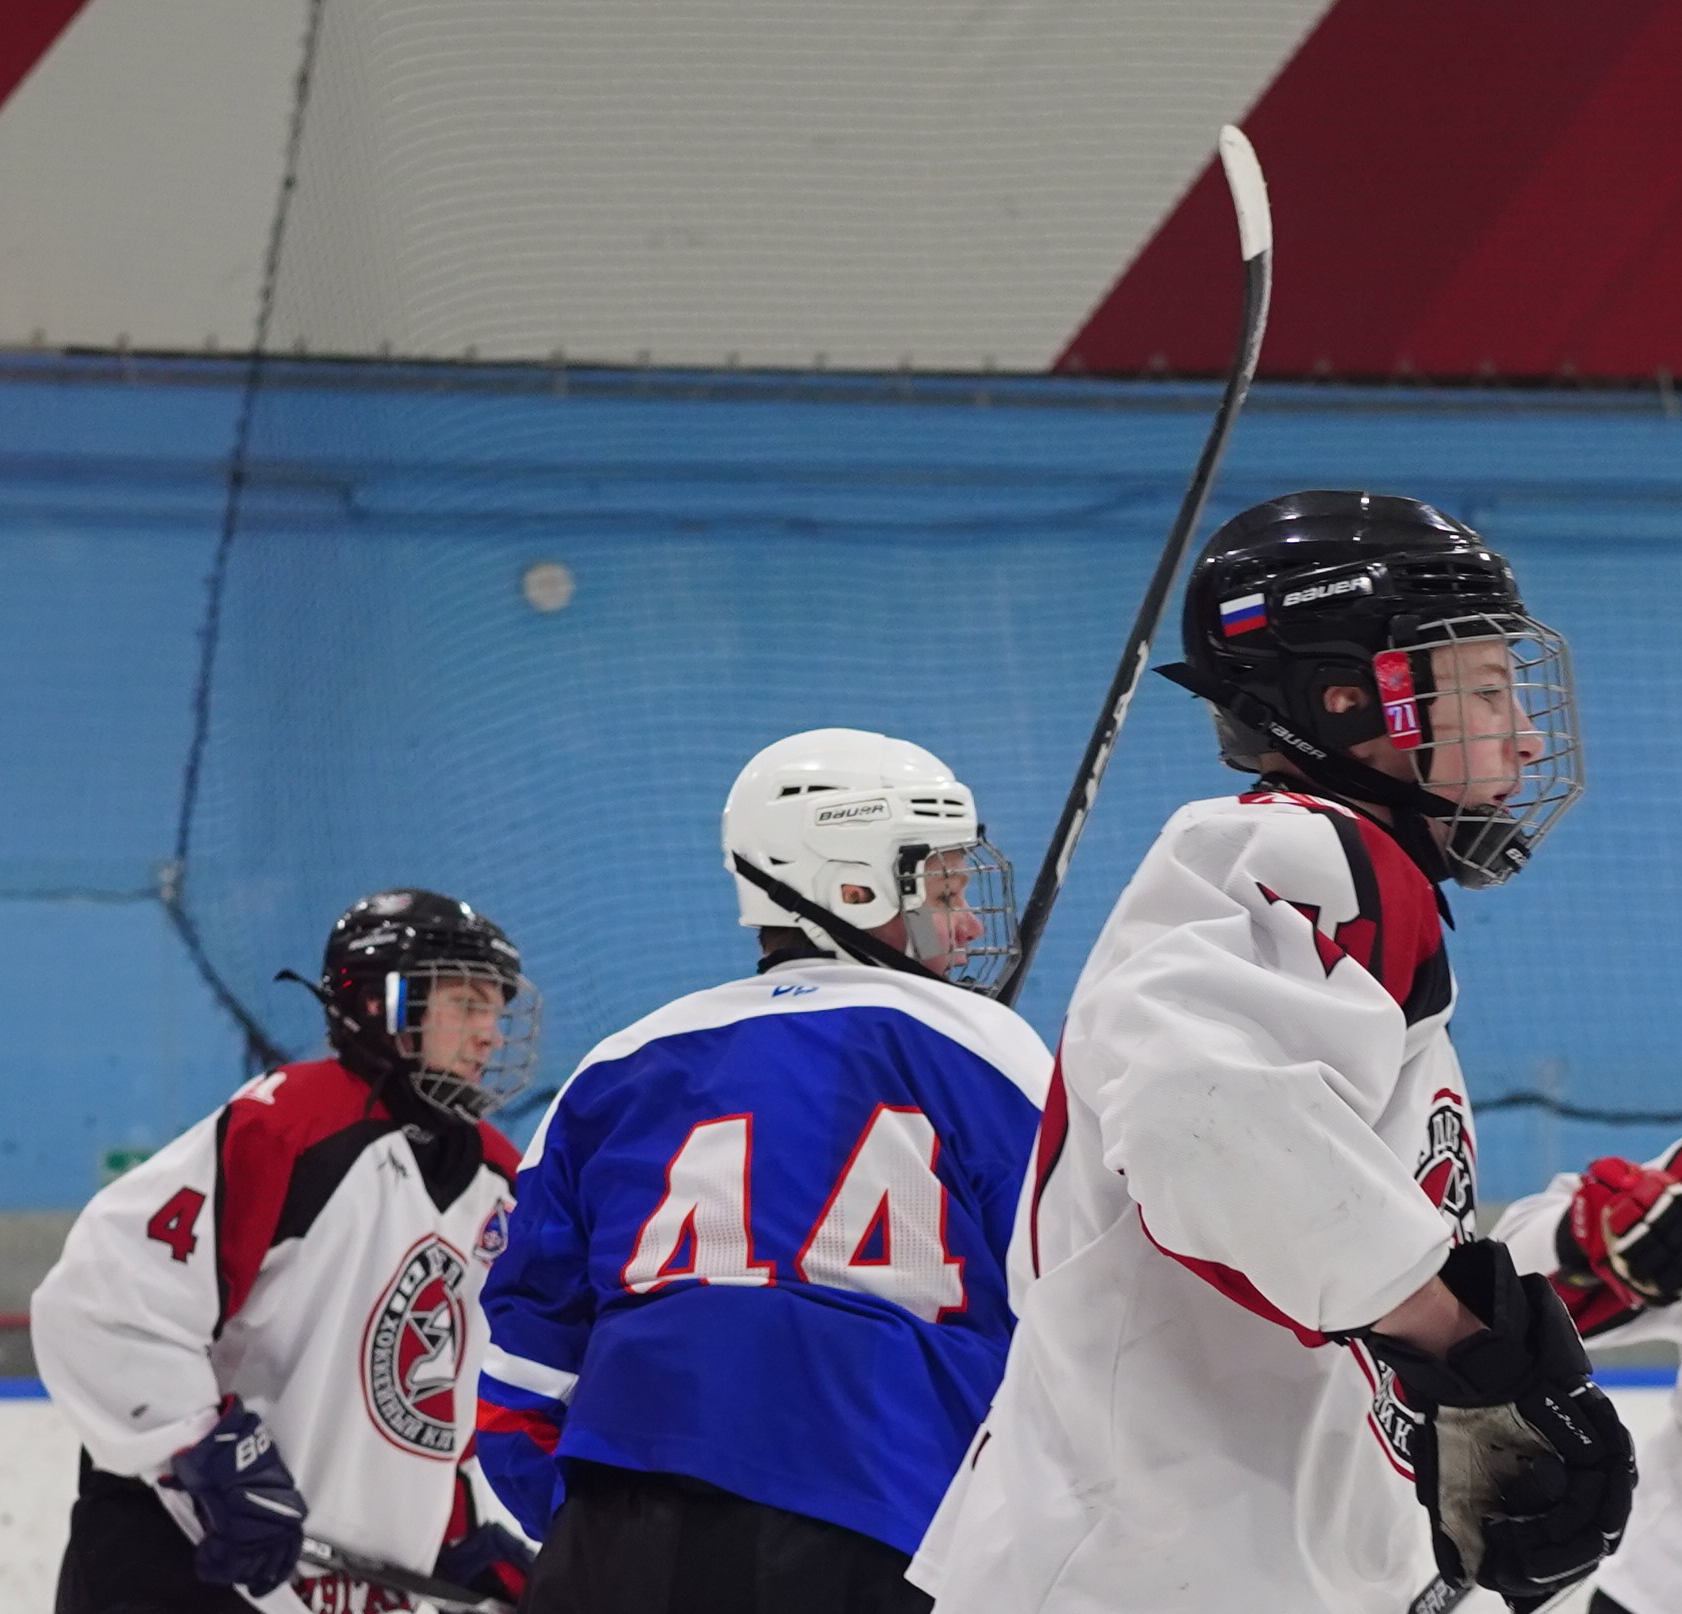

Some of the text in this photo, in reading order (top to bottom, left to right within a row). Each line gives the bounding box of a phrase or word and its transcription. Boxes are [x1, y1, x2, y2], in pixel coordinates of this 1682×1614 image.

[1283, 577, 1374, 607] BAUER
[1387, 703, 1417, 732] 71
[1269, 720, 1328, 761] AUER
[818, 803, 885, 821] BAUER
[146, 1186, 207, 1263] 4
[619, 1102, 967, 1325] 44
